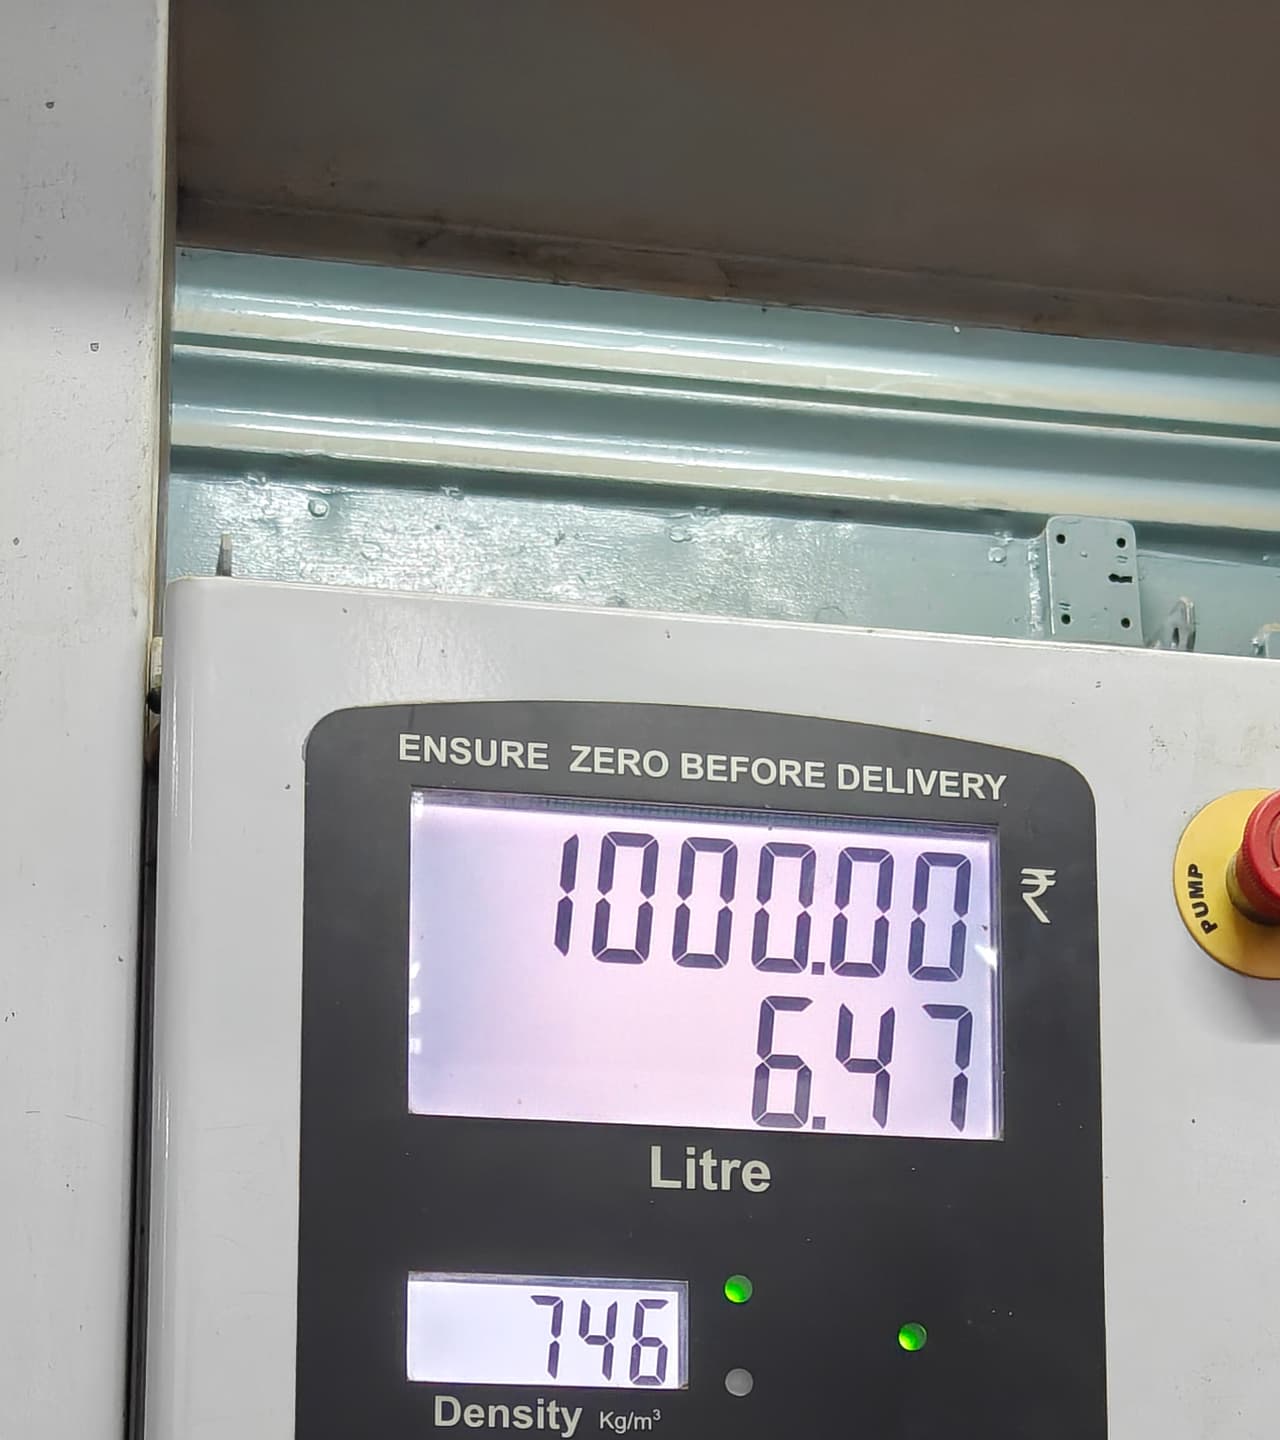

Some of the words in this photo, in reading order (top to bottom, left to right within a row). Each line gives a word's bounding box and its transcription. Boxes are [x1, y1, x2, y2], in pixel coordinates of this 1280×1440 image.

[399, 733, 549, 770] ENSURE
[570, 744, 670, 778] ZERO
[680, 752, 826, 789] BEFORE
[837, 763, 1008, 800] DELIVERY
[553, 831, 972, 982] 1000.00
[1187, 863, 1218, 934] PUMP
[751, 995, 974, 1131] 6.47
[650, 1146, 771, 1193] Litre
[530, 1295, 669, 1386] 746
[434, 1395, 583, 1438] Density
